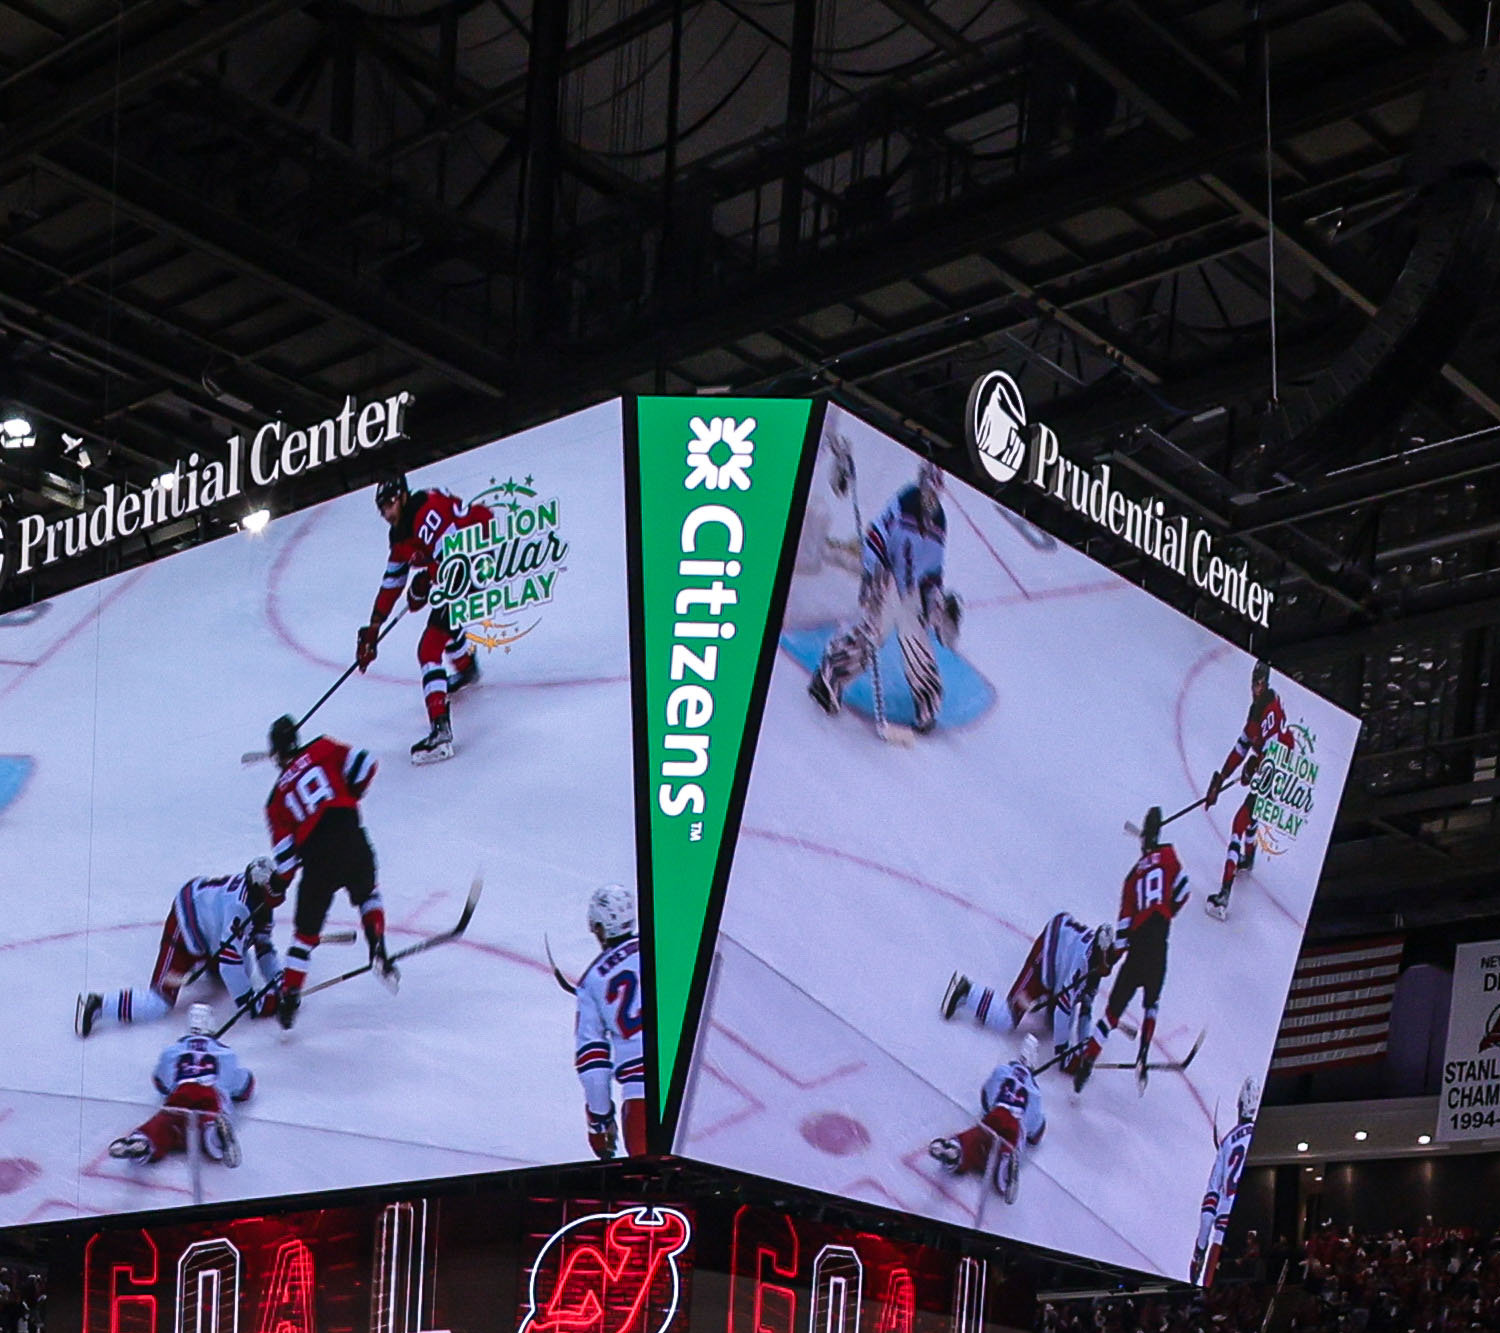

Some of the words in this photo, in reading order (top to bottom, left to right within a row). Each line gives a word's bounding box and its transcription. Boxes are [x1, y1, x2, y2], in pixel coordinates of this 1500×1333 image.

[17, 436, 240, 574] Prudential
[250, 391, 409, 486] Center
[444, 500, 557, 555] MILLION
[1036, 424, 1191, 579] Prudential
[1195, 533, 1274, 629] Center
[451, 571, 555, 625] REPLAY
[658, 505, 745, 819] Citizens
[1266, 741, 1319, 784] MILLION
[1255, 799, 1302, 836] REPLAY
